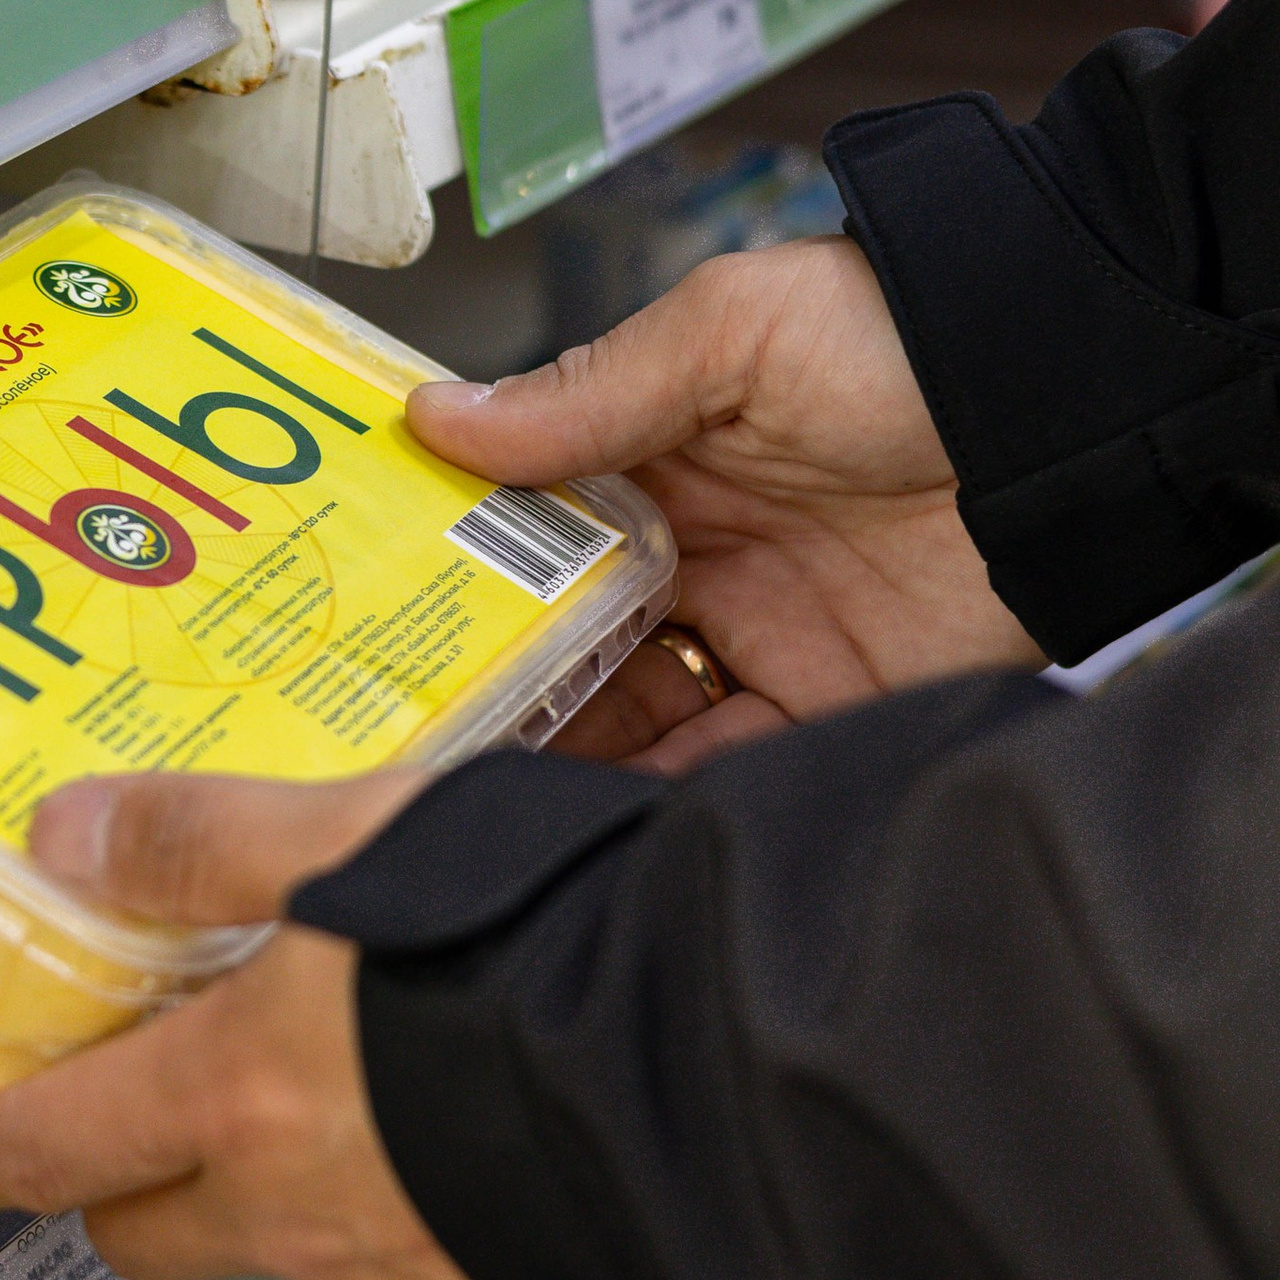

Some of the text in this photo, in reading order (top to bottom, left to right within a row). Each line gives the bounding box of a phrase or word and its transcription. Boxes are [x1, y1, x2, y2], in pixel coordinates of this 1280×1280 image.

[301, 515, 319, 528] 120
[314, 500, 340, 519] суток
[275, 553, 301, 572] суток
[418, 580, 441, 596] Саха
[432, 556, 470, 583] (Якутия),
[546, 564, 579, 594] 603736
[576, 537, 609, 565] 374092
[399, 623, 416, 634] ул.
[463, 569, 476, 578] 16
[388, 649, 409, 664] СПК
[414, 628, 459, 662] Таттинский
